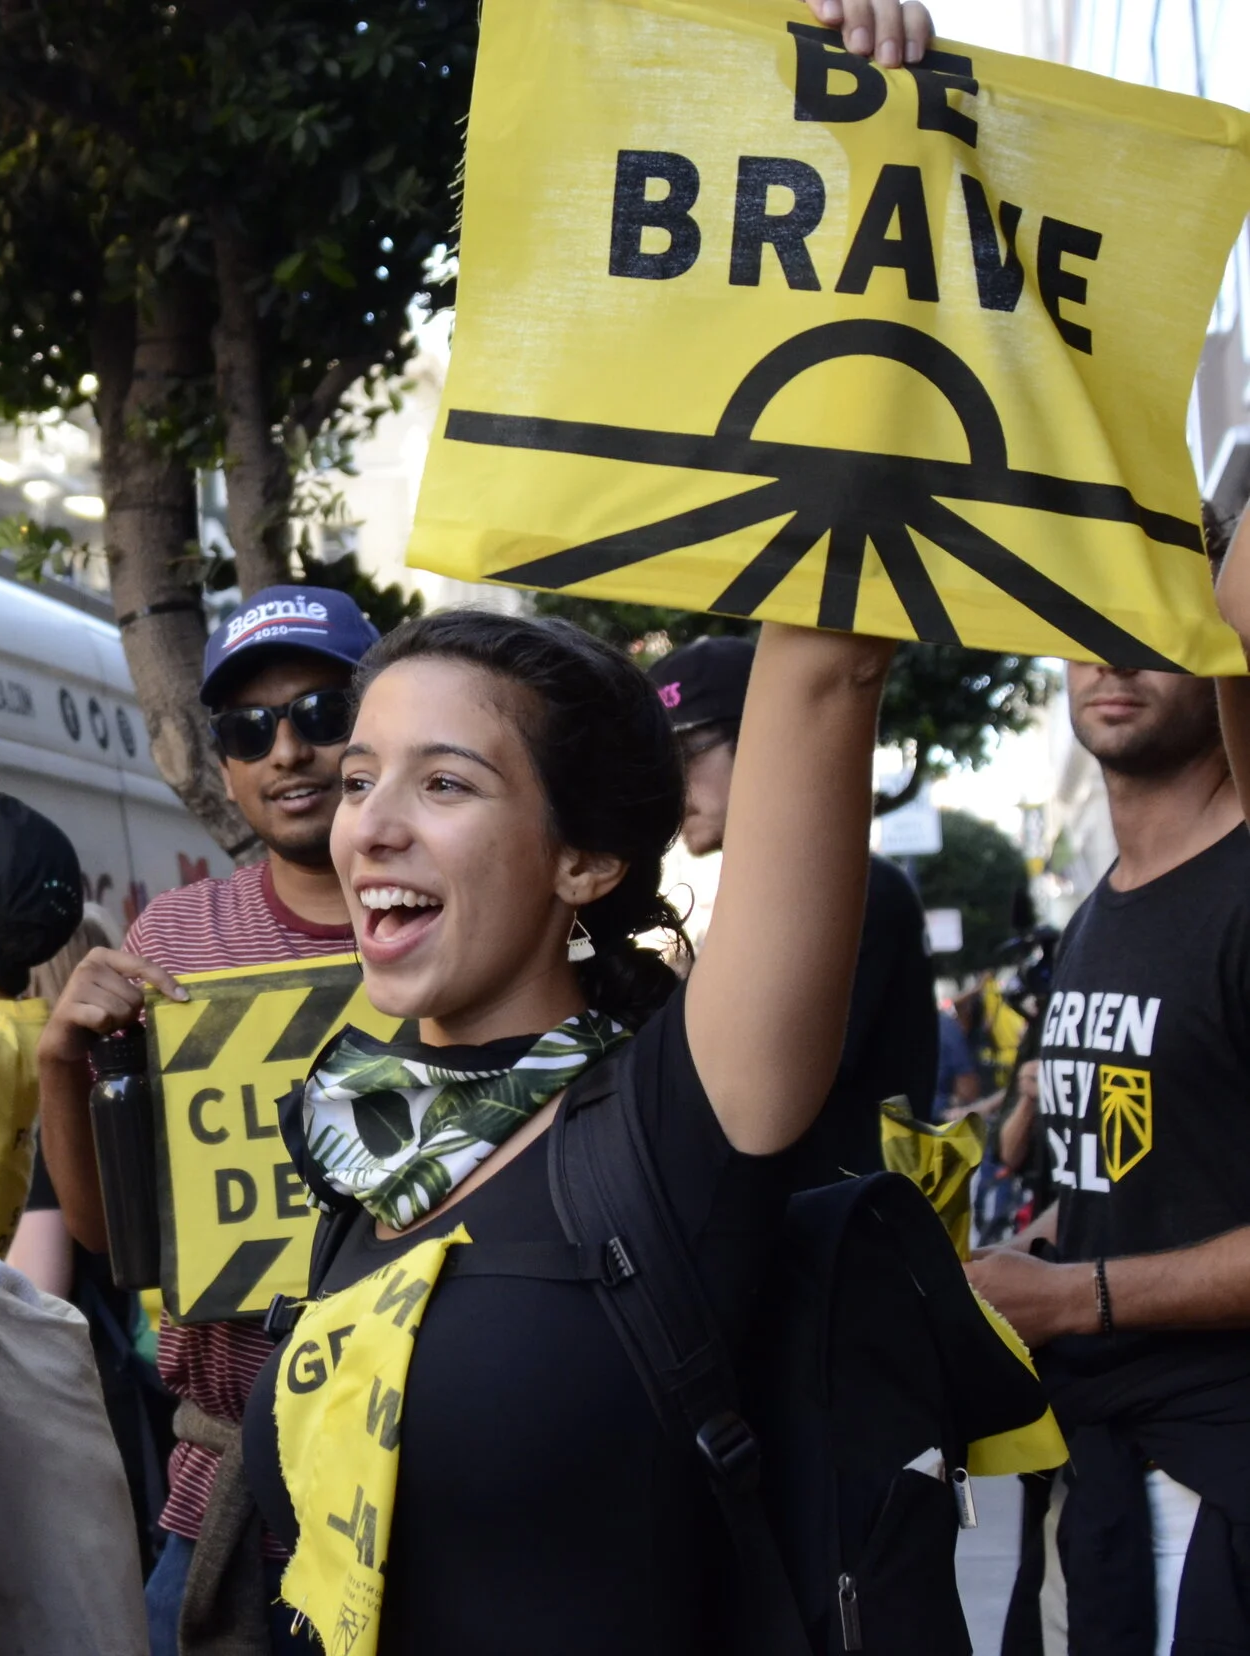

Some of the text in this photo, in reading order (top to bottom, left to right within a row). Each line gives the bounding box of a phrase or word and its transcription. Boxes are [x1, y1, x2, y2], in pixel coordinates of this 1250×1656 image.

[787, 21, 979, 149] BE
[608, 149, 1102, 356] BRAVE
[222, 595, 329, 648] Bernie
[253, 625, 288, 640] 2020
[1041, 990, 1161, 1057] GREEN
[188, 1078, 304, 1145] CL
